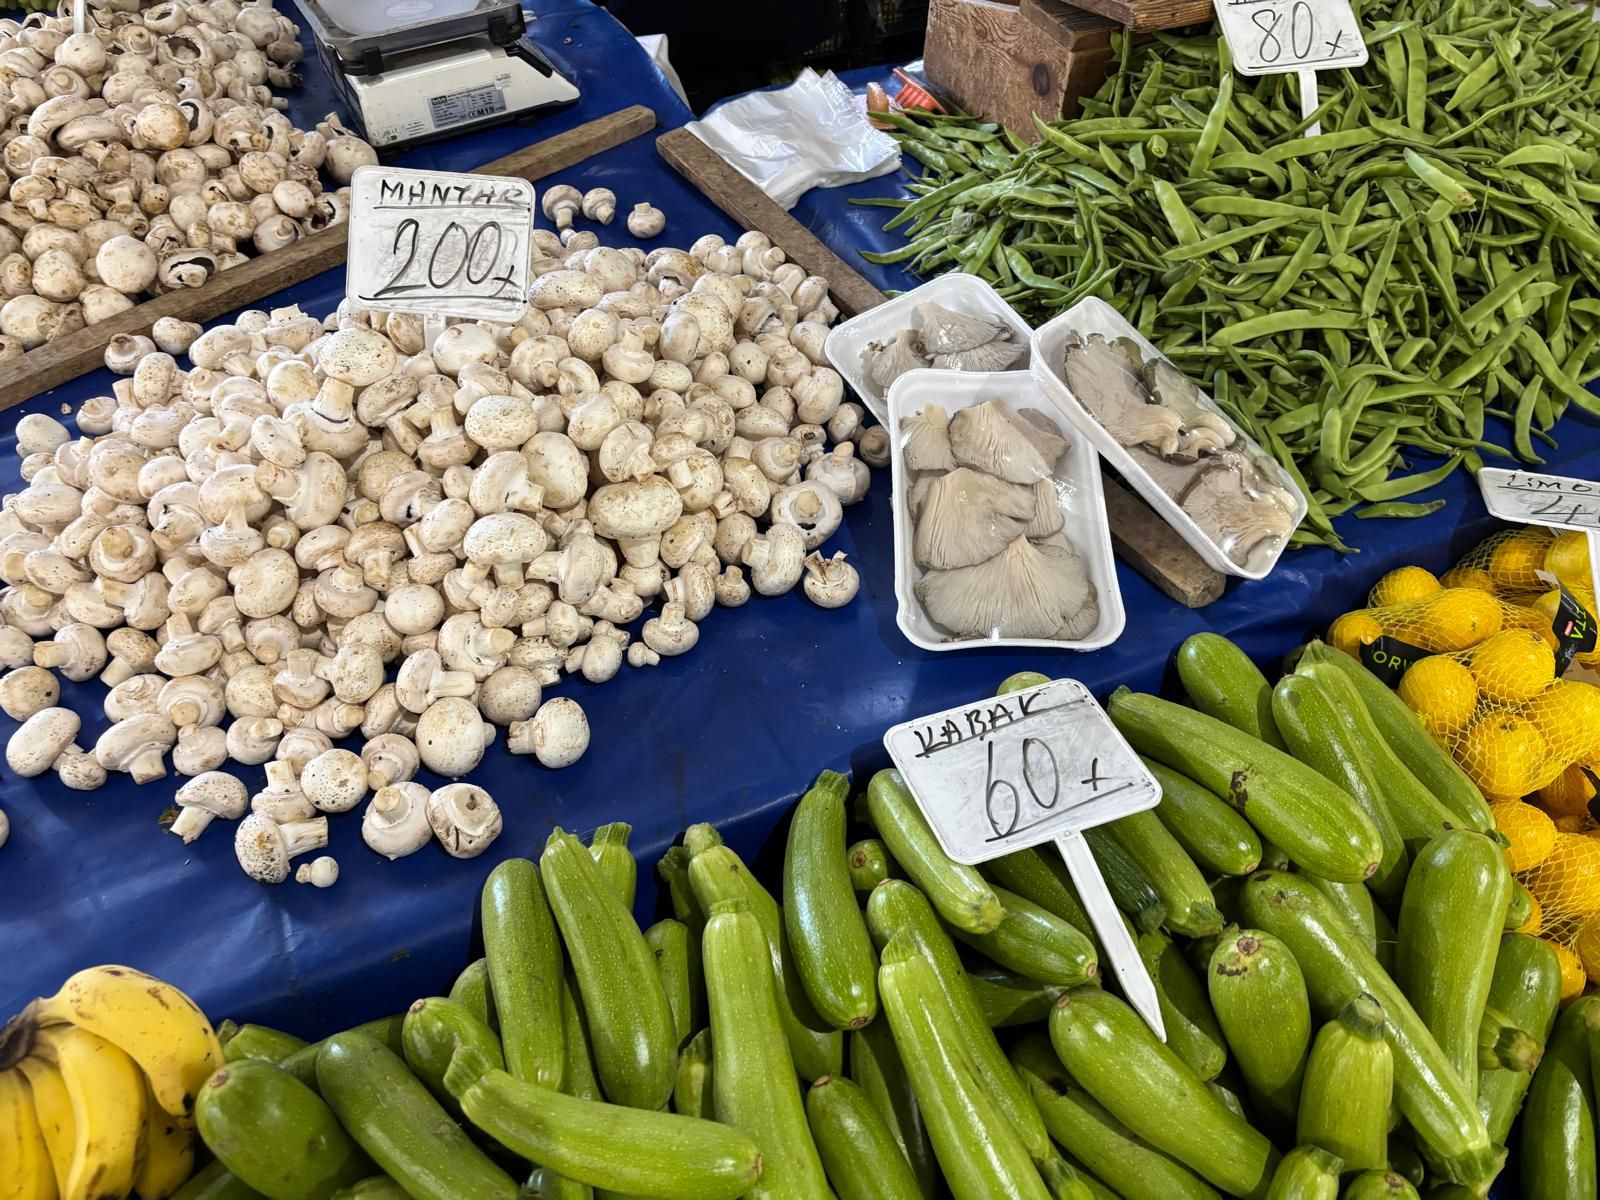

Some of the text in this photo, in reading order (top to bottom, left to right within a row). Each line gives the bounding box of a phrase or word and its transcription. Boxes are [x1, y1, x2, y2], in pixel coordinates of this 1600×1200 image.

[1251, 1, 1314, 62] 80
[379, 178, 526, 206] MANTAR
[373, 217, 502, 297] 200
[913, 692, 1046, 754] KABAK
[985, 738, 1059, 837] 60
